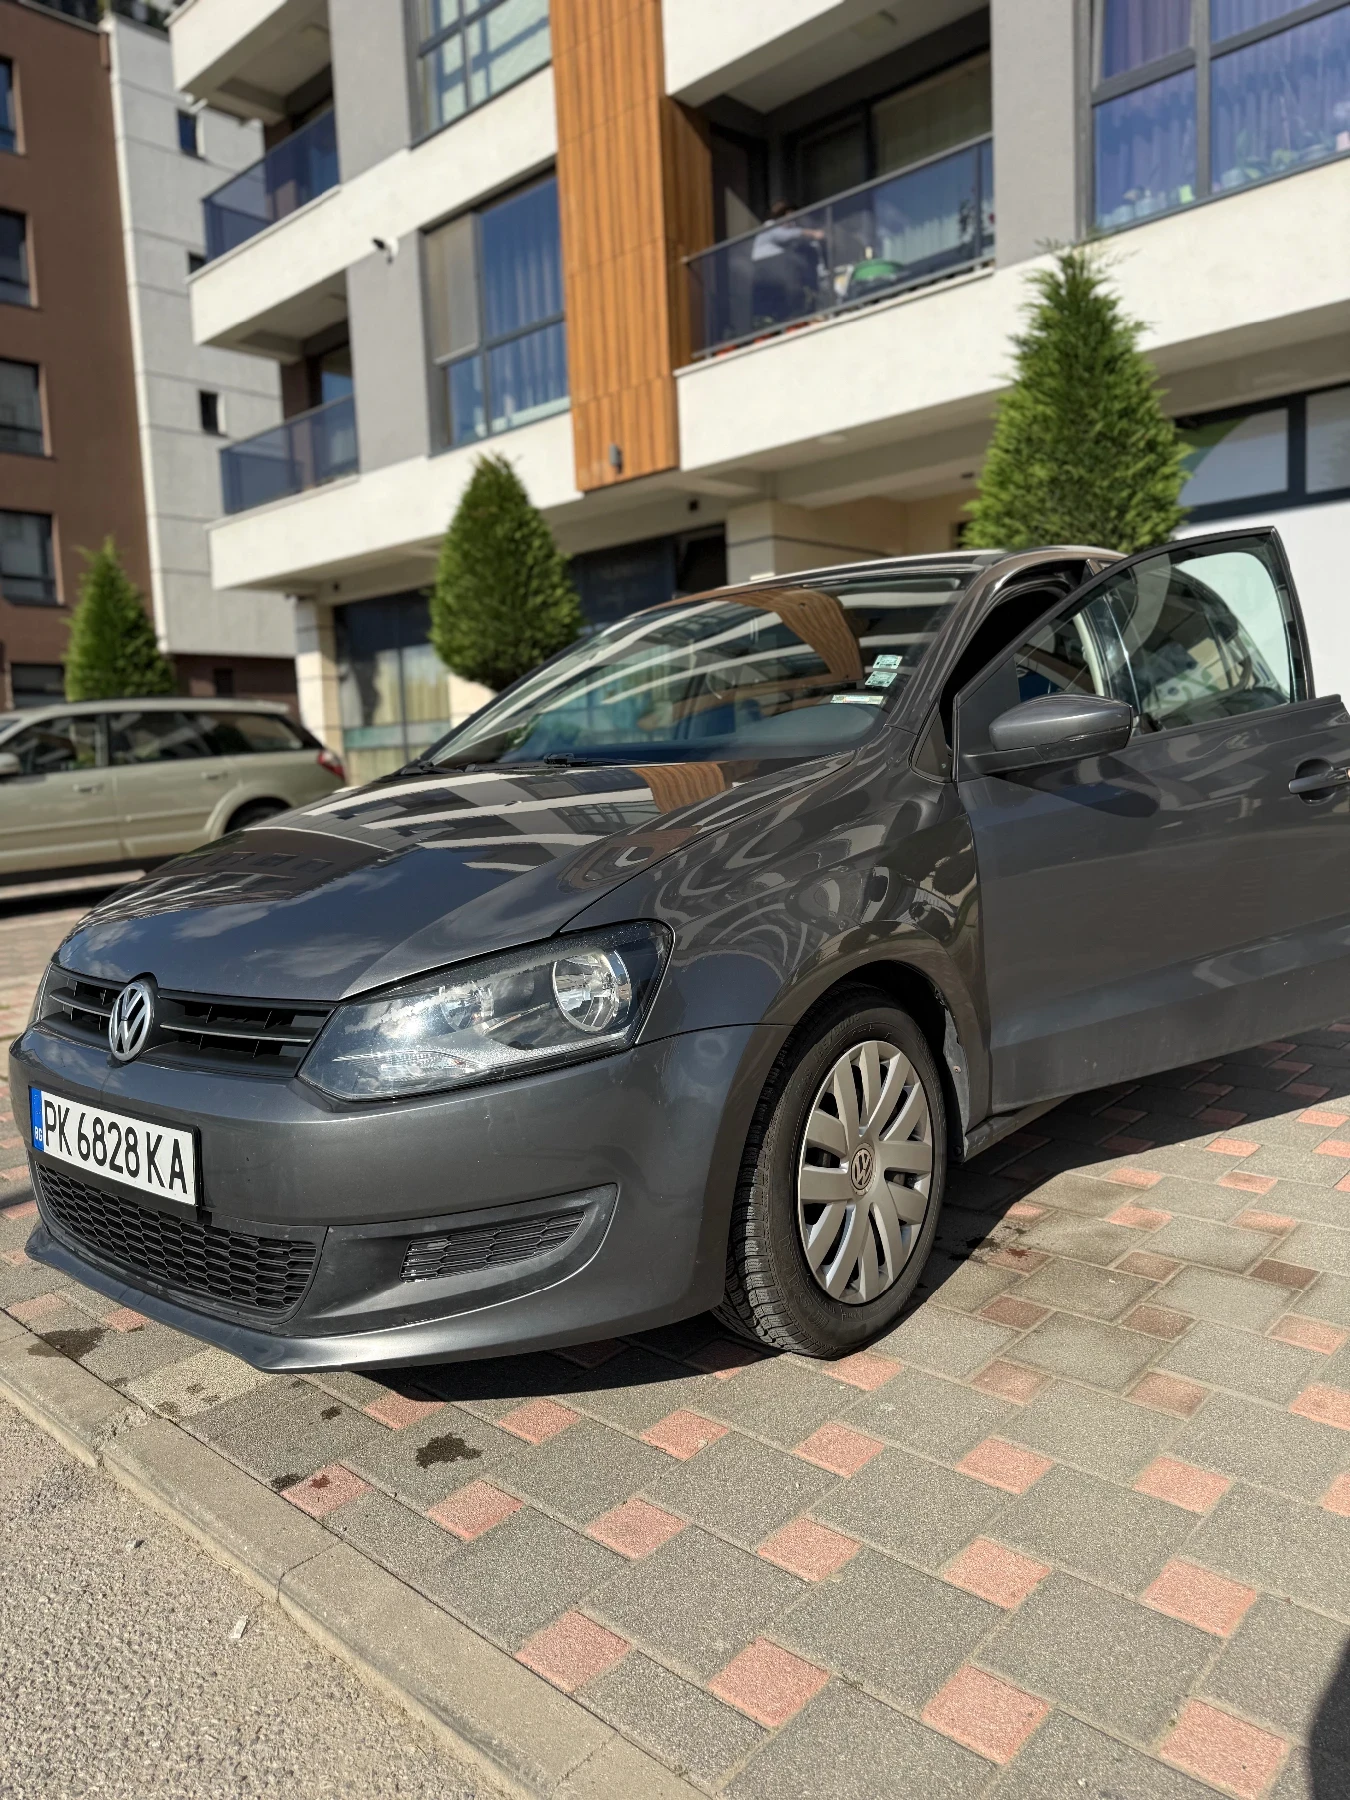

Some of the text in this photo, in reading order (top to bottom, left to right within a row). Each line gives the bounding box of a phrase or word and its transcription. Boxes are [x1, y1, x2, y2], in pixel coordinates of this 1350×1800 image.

[109, 983, 150, 1061] VW
[34, 1126, 43, 1142] BG
[43, 1099, 188, 1195] PK 6828 KA
[851, 1148, 873, 1190] VW
